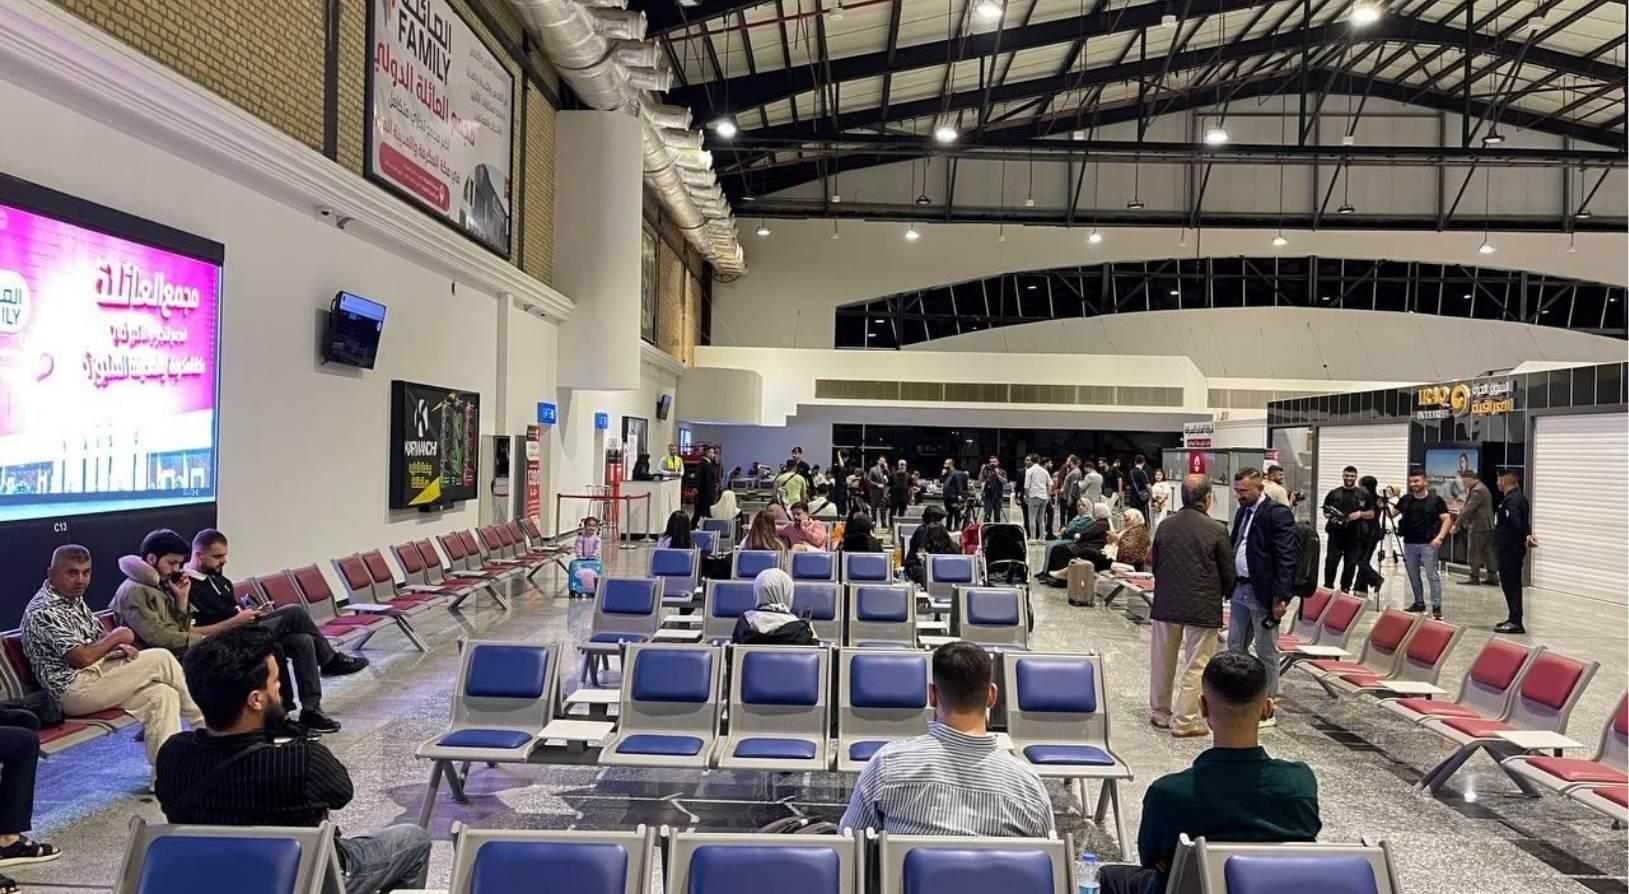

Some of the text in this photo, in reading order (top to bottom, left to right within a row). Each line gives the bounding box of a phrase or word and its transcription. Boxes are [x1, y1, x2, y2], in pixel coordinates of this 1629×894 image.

[374, 42, 413, 94] الدولي
[399, 8, 450, 86] FAMILY
[416, 74, 448, 124] العائلة
[161, 284, 200, 321] مجمع
[1418, 386, 1450, 407] IRAQ
[54, 522, 67, 533] C13
